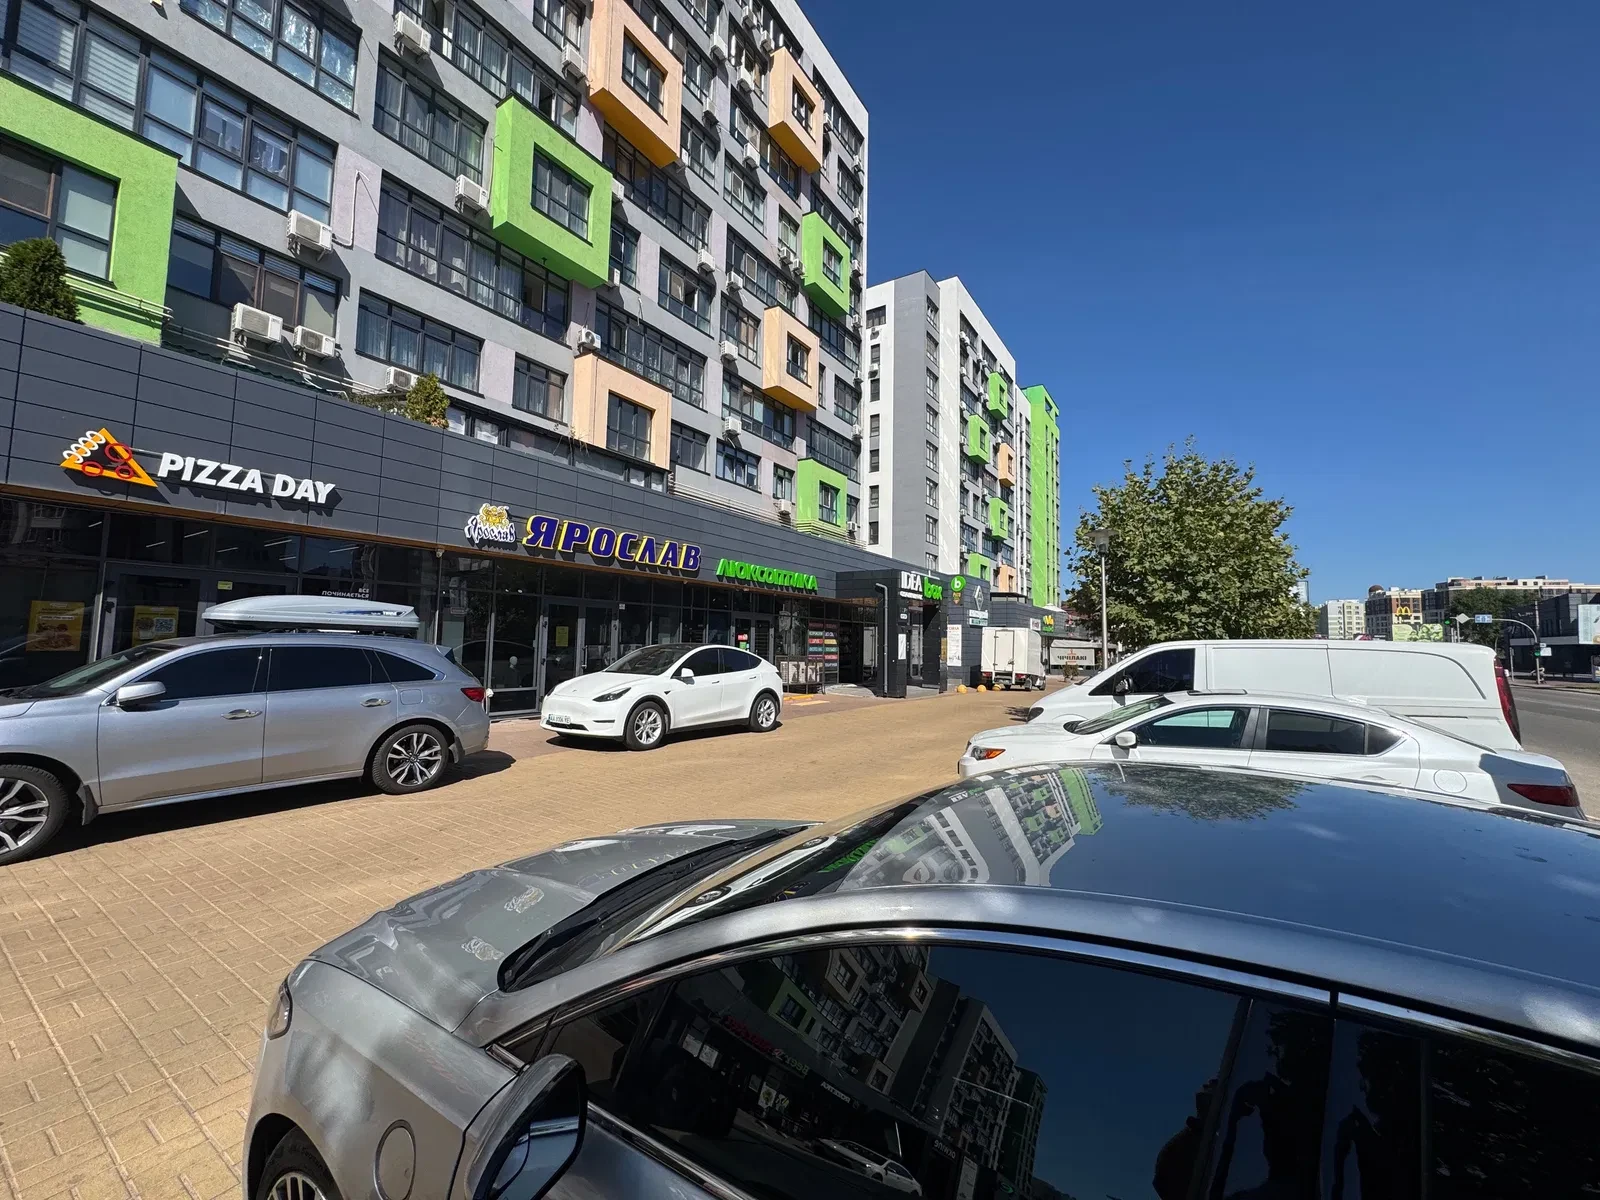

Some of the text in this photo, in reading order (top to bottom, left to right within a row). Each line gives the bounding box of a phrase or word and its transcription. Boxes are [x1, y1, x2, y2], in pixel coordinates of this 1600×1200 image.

[157, 452, 336, 505] PIZZA DAY
[464, 515, 516, 544] Ярослав
[522, 514, 702, 572] ЯРОСЛАВ
[716, 558, 819, 592] ЛЮКСОПТИКА
[901, 571, 923, 593] IDEA
[924, 576, 943, 601] box
[322, 590, 369, 598] ПОЧИНАЄТЬСЯ
